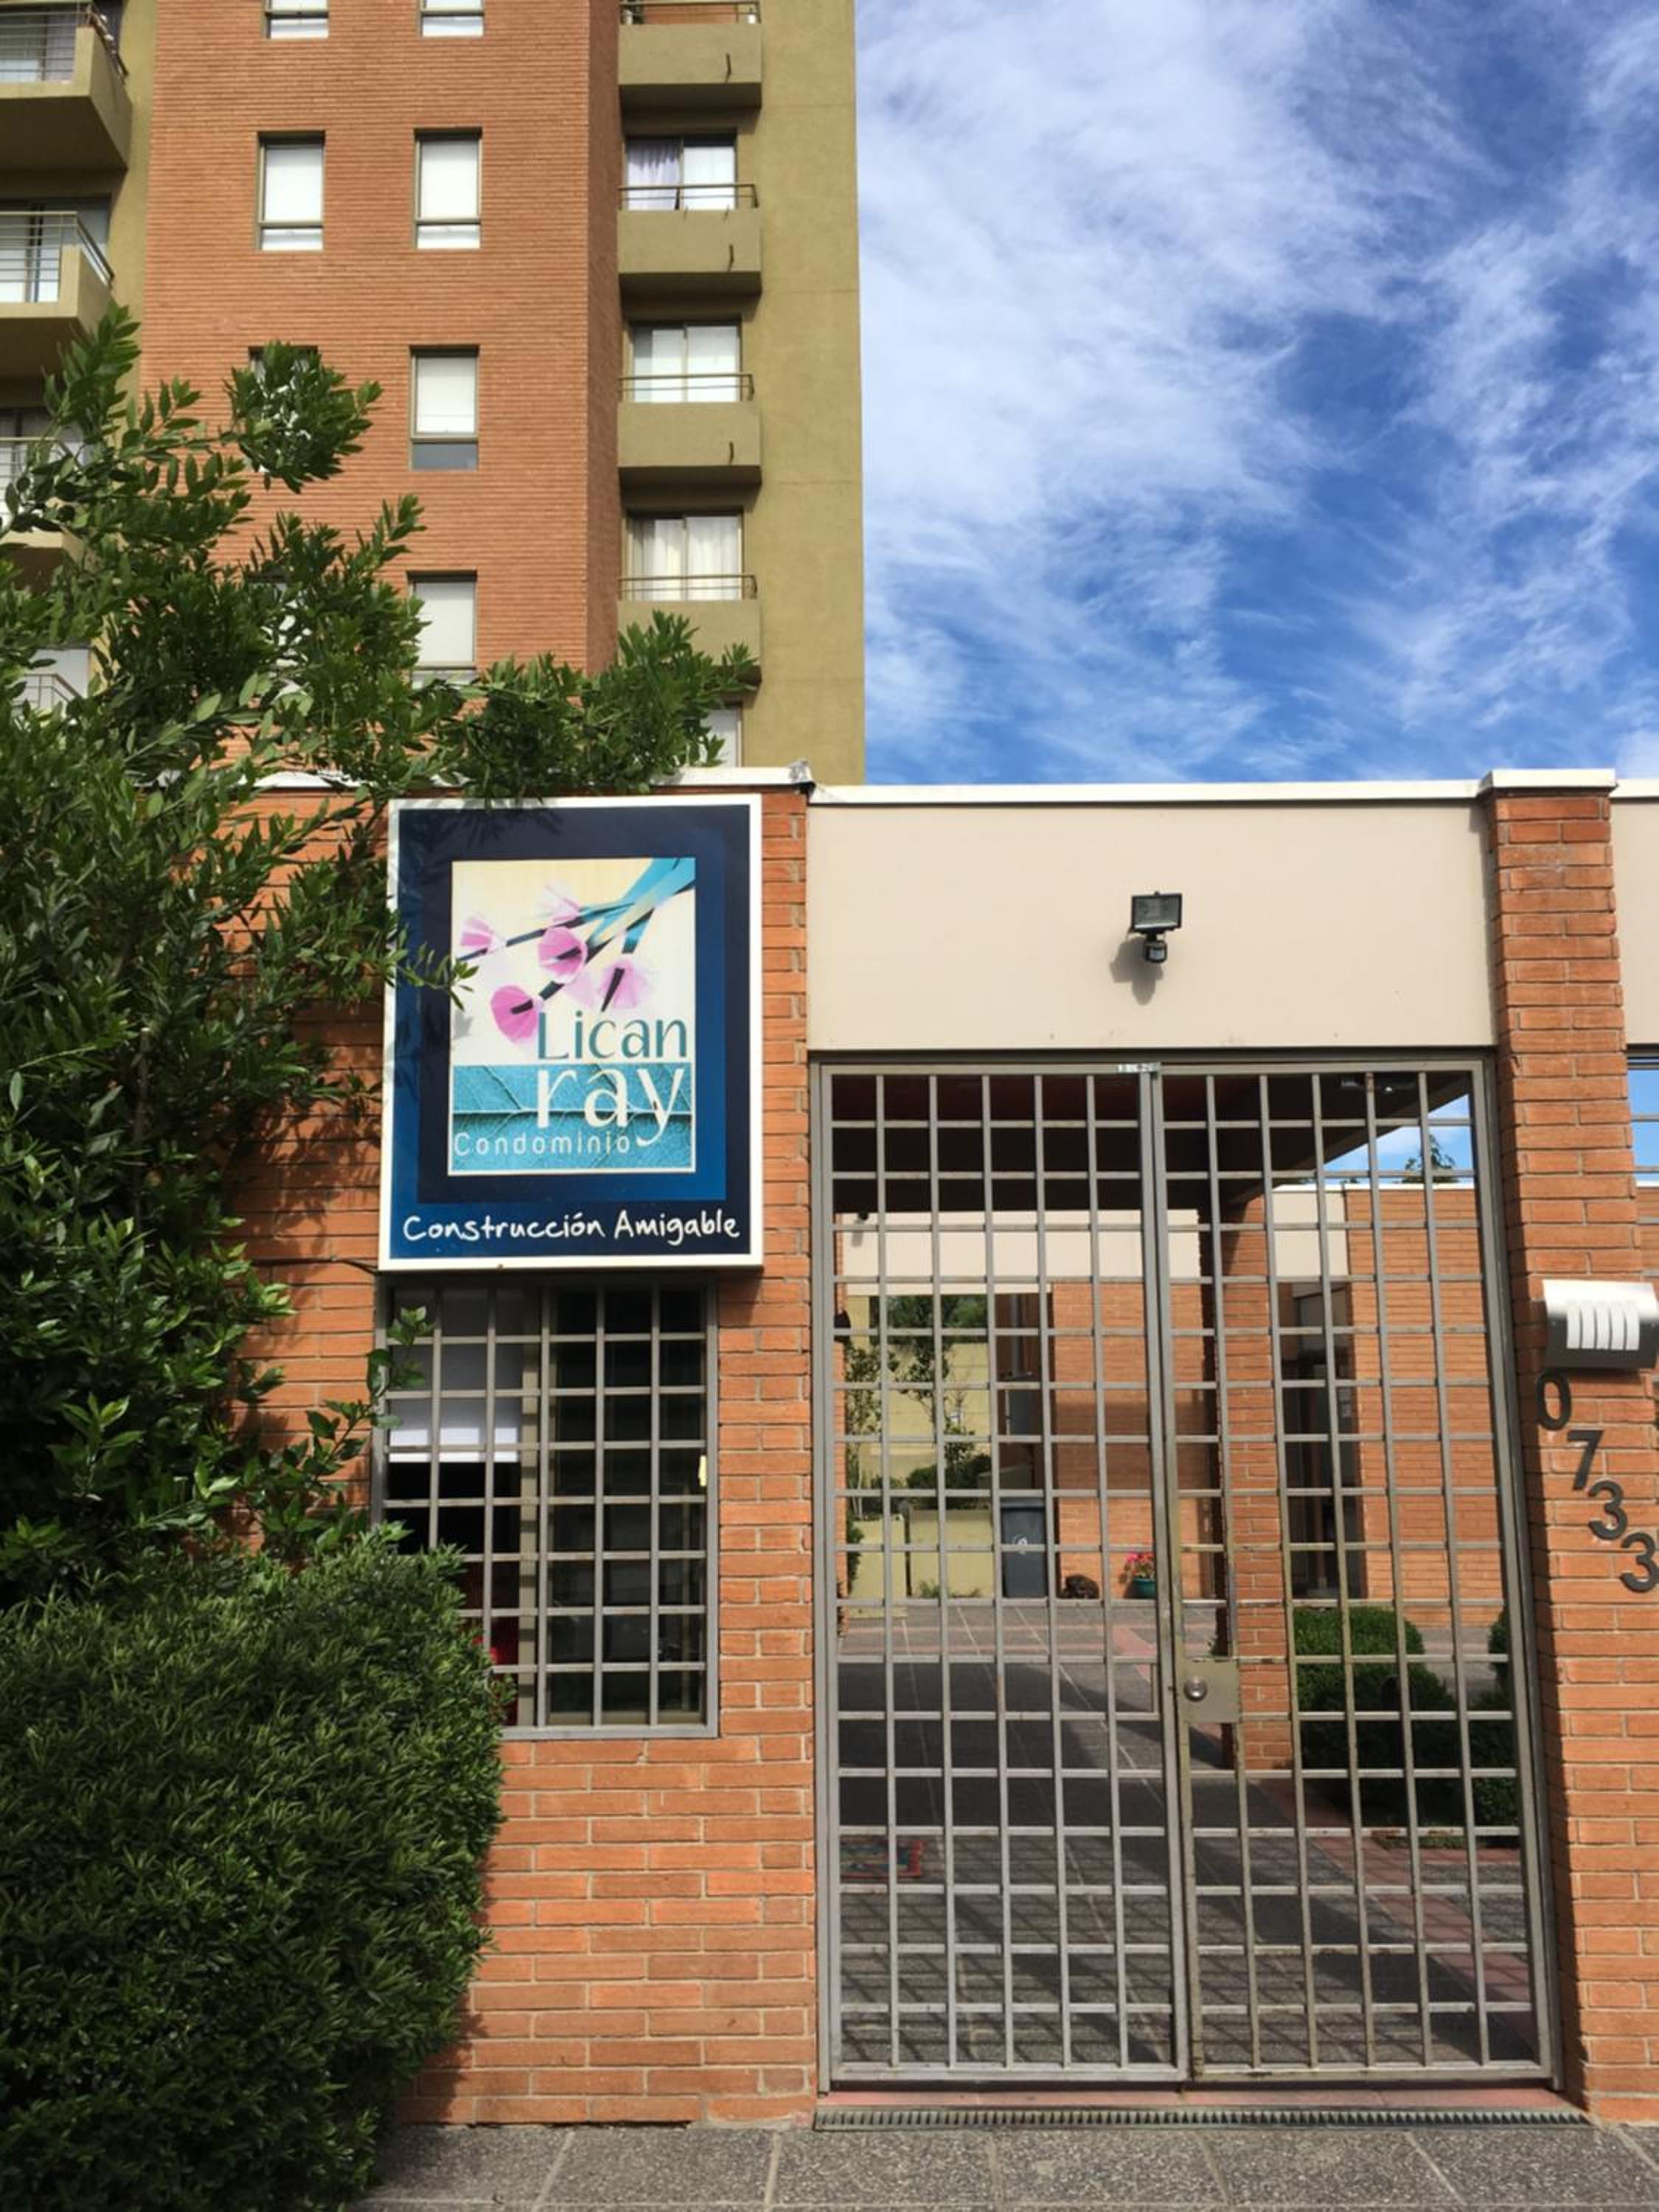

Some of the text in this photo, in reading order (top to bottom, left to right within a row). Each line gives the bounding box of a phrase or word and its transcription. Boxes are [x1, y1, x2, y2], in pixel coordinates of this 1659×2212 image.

[538, 1010, 687, 1060] Lican
[536, 1068, 685, 1147] ray
[454, 1132, 630, 1156] Condominio
[403, 1208, 740, 1246] Construcción Amigable
